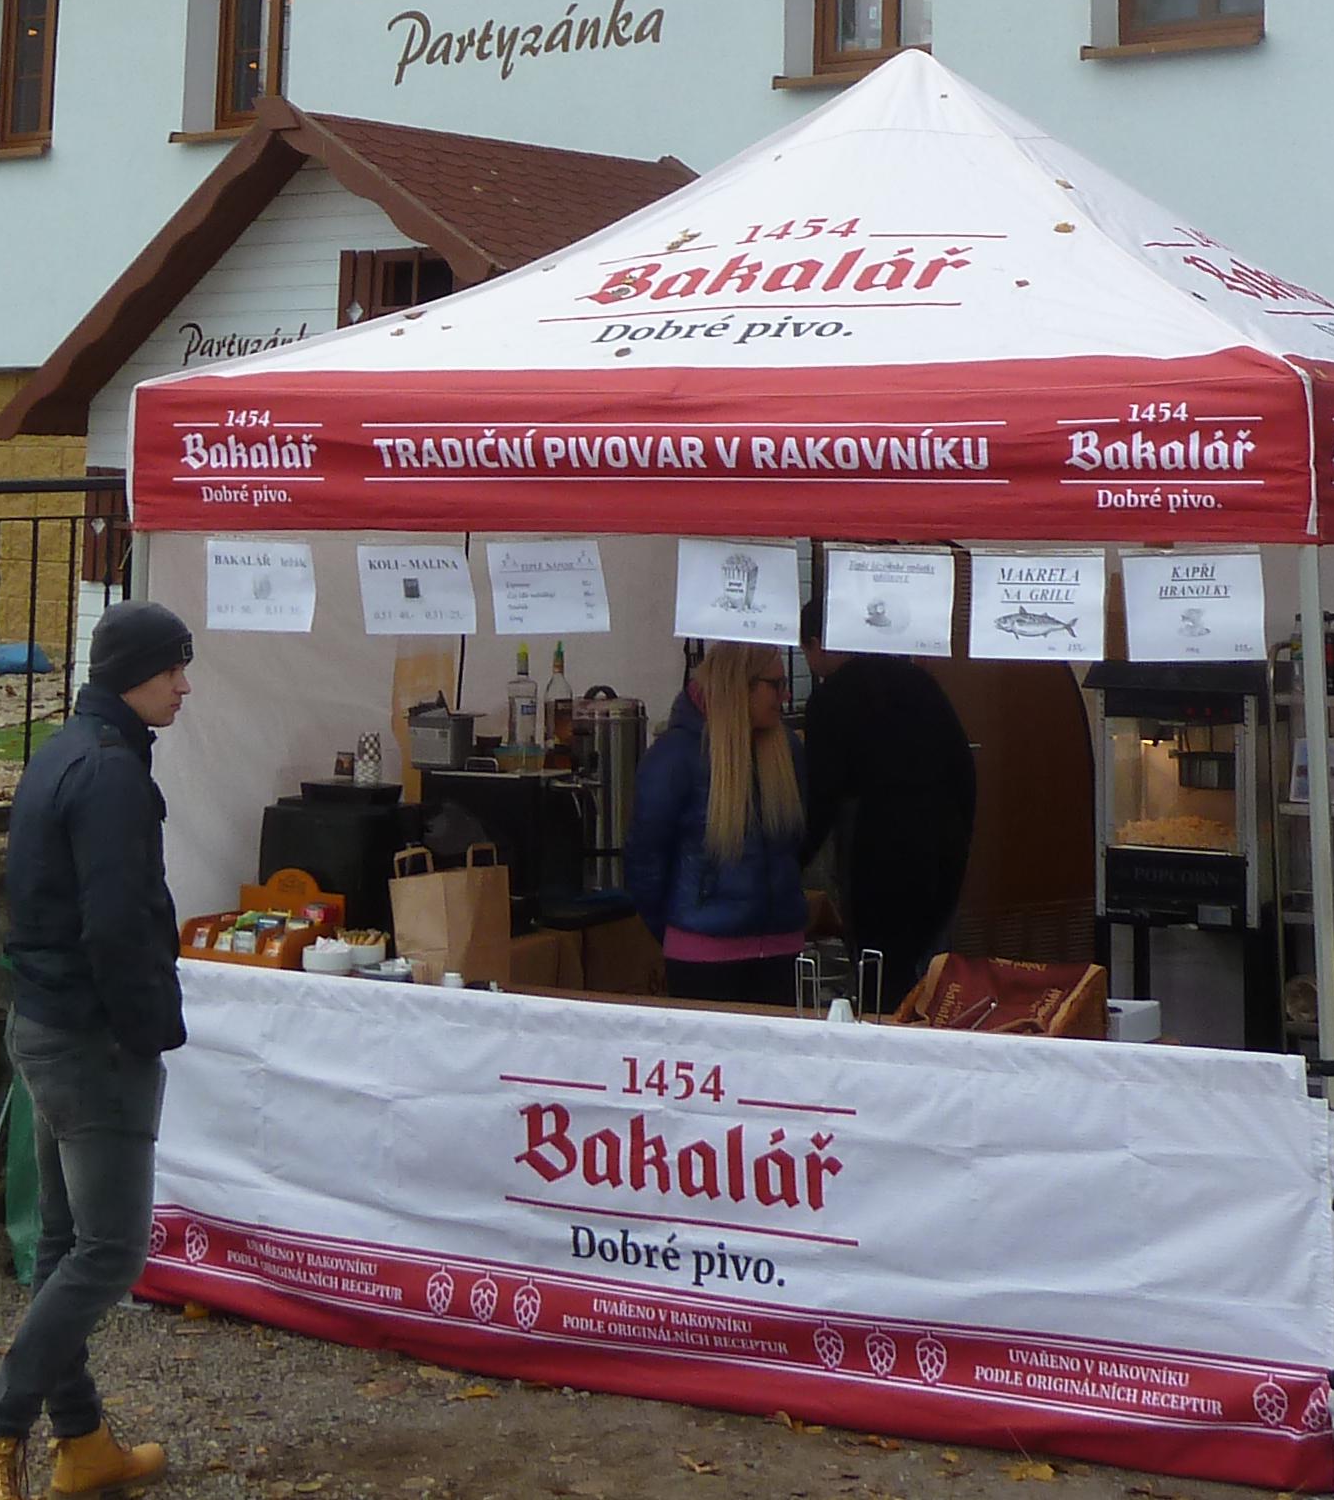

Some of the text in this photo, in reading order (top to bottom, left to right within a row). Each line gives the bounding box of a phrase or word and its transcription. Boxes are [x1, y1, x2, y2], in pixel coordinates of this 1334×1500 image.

[735, 217, 861, 245] 1454
[575, 246, 973, 305] Bakalář
[179, 322, 307, 366] Partyzá
[591, 314, 853, 345] Dobré pivo.
[224, 410, 270, 427] 1454
[1127, 402, 1188, 422] 1454
[180, 432, 318, 469] Bakalář
[373, 428, 989, 470] TRADIČNÍ PIVOVAR V RAKOVNÍKU
[1065, 429, 1256, 471] Bakalář
[201, 484, 292, 507] Dobré pivo.
[1097, 487, 1222, 514] Dobré pivo.
[998, 567, 1080, 583] MAKRELA
[1159, 585, 1231, 597] HRANOLKY
[1133, 867, 1219, 886] POPCORN
[622, 1056, 725, 1102] 1454
[514, 1102, 844, 1211] Bakalář
[295, 1250, 305, 1264] V
[307, 1253, 378, 1276] RAKOVNÍKU
[570, 1225, 785, 1287] Dobré pivo.
[260, 1261, 338, 1290] ORIGINÁLNÍCH
[341, 1278, 403, 1301] RECEPTUR
[593, 1298, 752, 1333] UVAŘENO V RAKOVNÍKU
[562, 1314, 789, 1355] PODLE ORIGINÁLNÍCH RECEPTUR
[1008, 1348, 1190, 1387] UVAŘENO V RAKOVNÍKU
[974, 1365, 1224, 1416] PODLE ORIGINÁLNÍCH RECEPTUR
